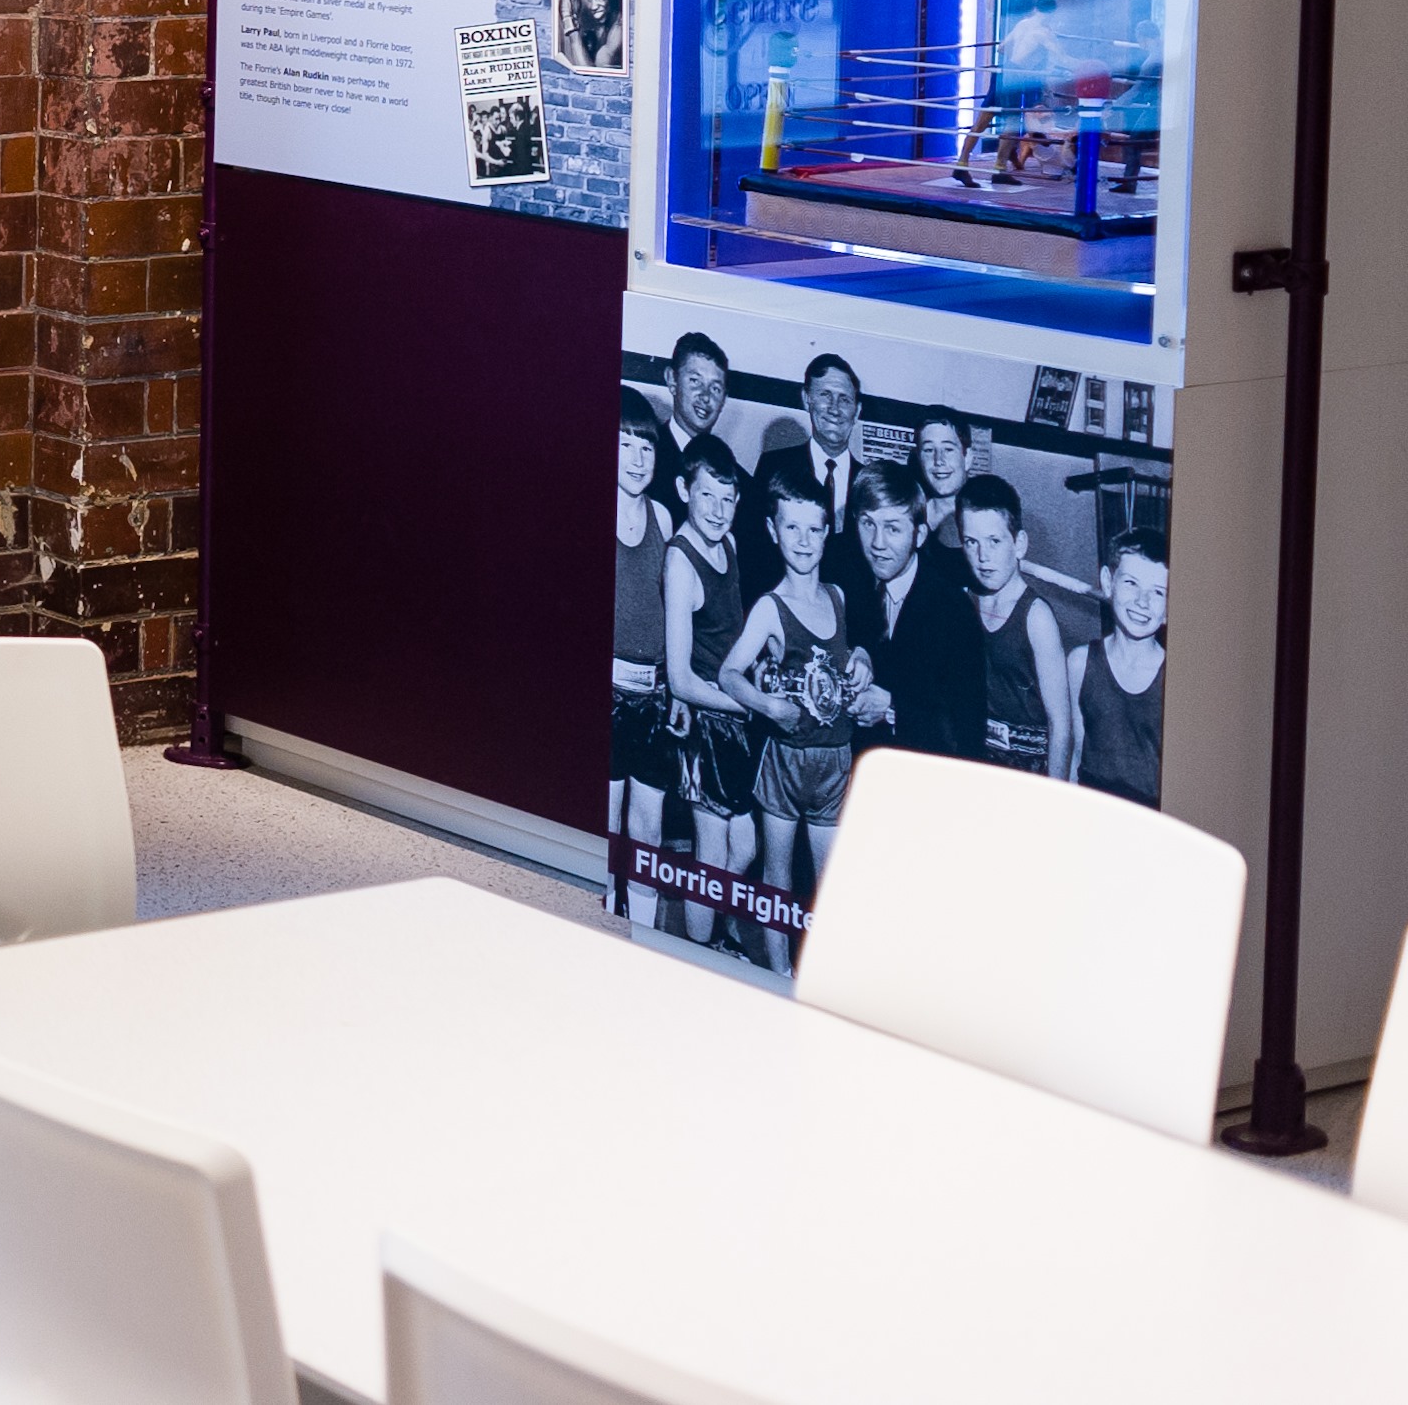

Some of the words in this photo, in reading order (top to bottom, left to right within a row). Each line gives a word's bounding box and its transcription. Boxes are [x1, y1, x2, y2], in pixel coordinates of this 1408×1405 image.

[242, 3, 263, 15] during
[265, 6, 276, 14] the
[344, 0, 365, 9] medal
[241, 25, 261, 37] Larry
[284, 30, 299, 39] born
[311, 33, 342, 44] Liverpool
[344, 38, 357, 47] and
[367, 39, 389, 50] Florrie
[459, 24, 532, 45] BOXING
[256, 42, 267, 51] the
[269, 43, 283, 52] ABA
[286, 44, 299, 56] light
[302, 48, 347, 62] middleweight
[350, 53, 383, 65] champion
[386, 57, 392, 66] in
[241, 62, 252, 71] The
[284, 68, 300, 77] Alan
[303, 70, 329, 81] Rudkin
[332, 75, 345, 83] was
[348, 77, 375, 88] perhaps
[378, 80, 389, 89] the
[489, 60, 534, 73] RUDKIN
[507, 70, 536, 81] PAUL
[240, 78, 267, 88] greatest
[270, 80, 291, 91] British
[294, 83, 312, 94] boxer
[315, 88, 334, 97] never
[346, 90, 362, 101] have
[365, 95, 379, 103] won
[389, 98, 408, 106] world
[257, 94, 280, 105] though
[282, 97, 290, 106] he
[293, 100, 311, 109] came
[314, 103, 328, 112] very
[635, 849, 723, 901] Florrie
